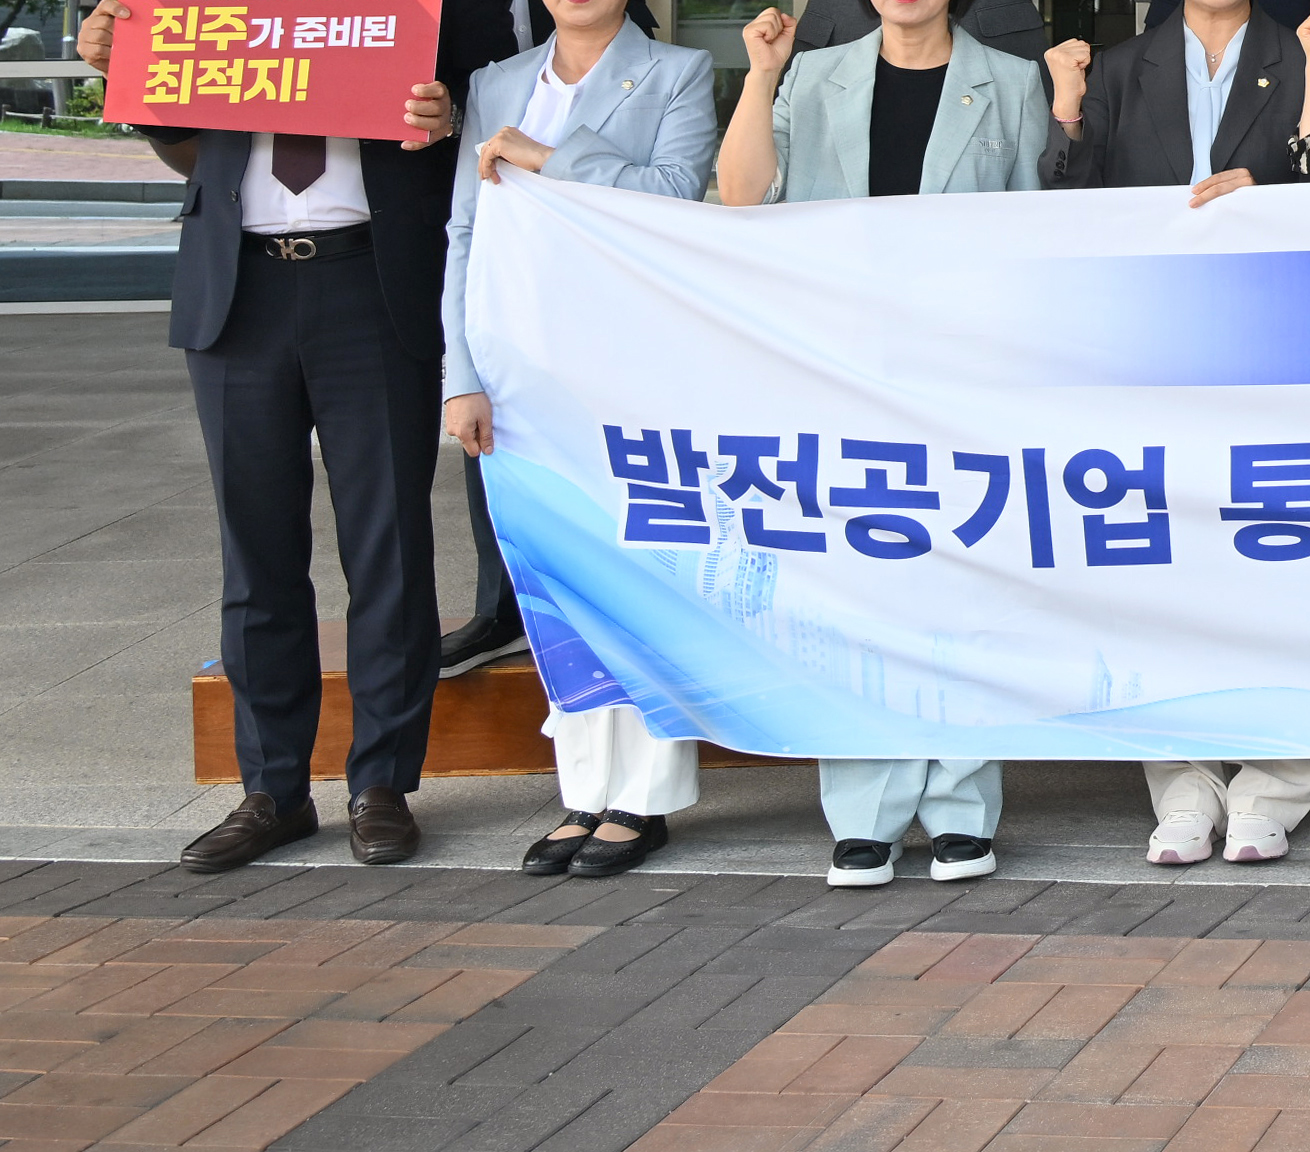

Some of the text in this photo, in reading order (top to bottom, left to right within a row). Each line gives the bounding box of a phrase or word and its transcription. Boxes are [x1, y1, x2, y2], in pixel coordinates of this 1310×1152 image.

[151, 7, 396, 51] 진주가 준비된
[143, 58, 310, 104] 최적지!
[602, 424, 1173, 570] 발전공기업
